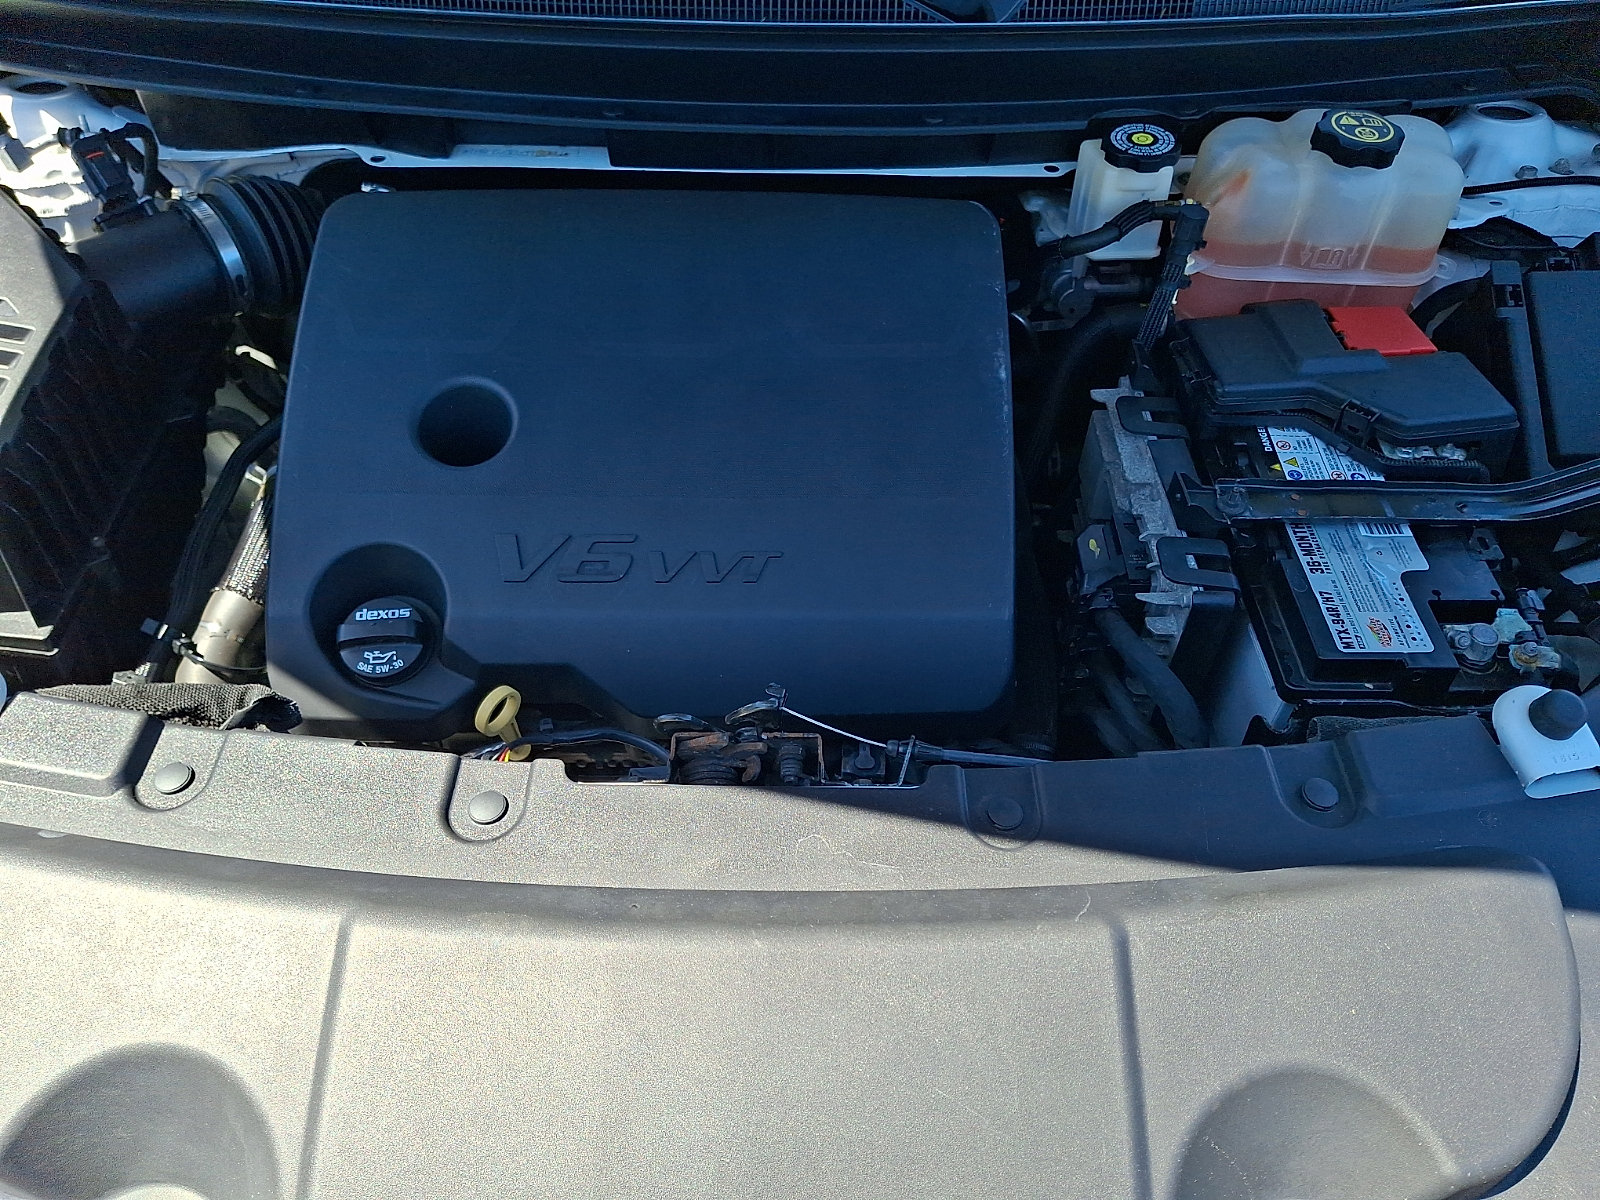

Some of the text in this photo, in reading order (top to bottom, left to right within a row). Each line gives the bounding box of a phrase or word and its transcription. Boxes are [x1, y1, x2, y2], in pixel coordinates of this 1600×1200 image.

[1257, 426, 1273, 452] DANGE
[495, 533, 785, 584] V6 VVT
[1290, 522, 1325, 575] 36-MONTH
[355, 607, 413, 621] dexos
[1318, 590, 1356, 650] MTX-94R/H7
[357, 659, 404, 674] SAE 5W-30
